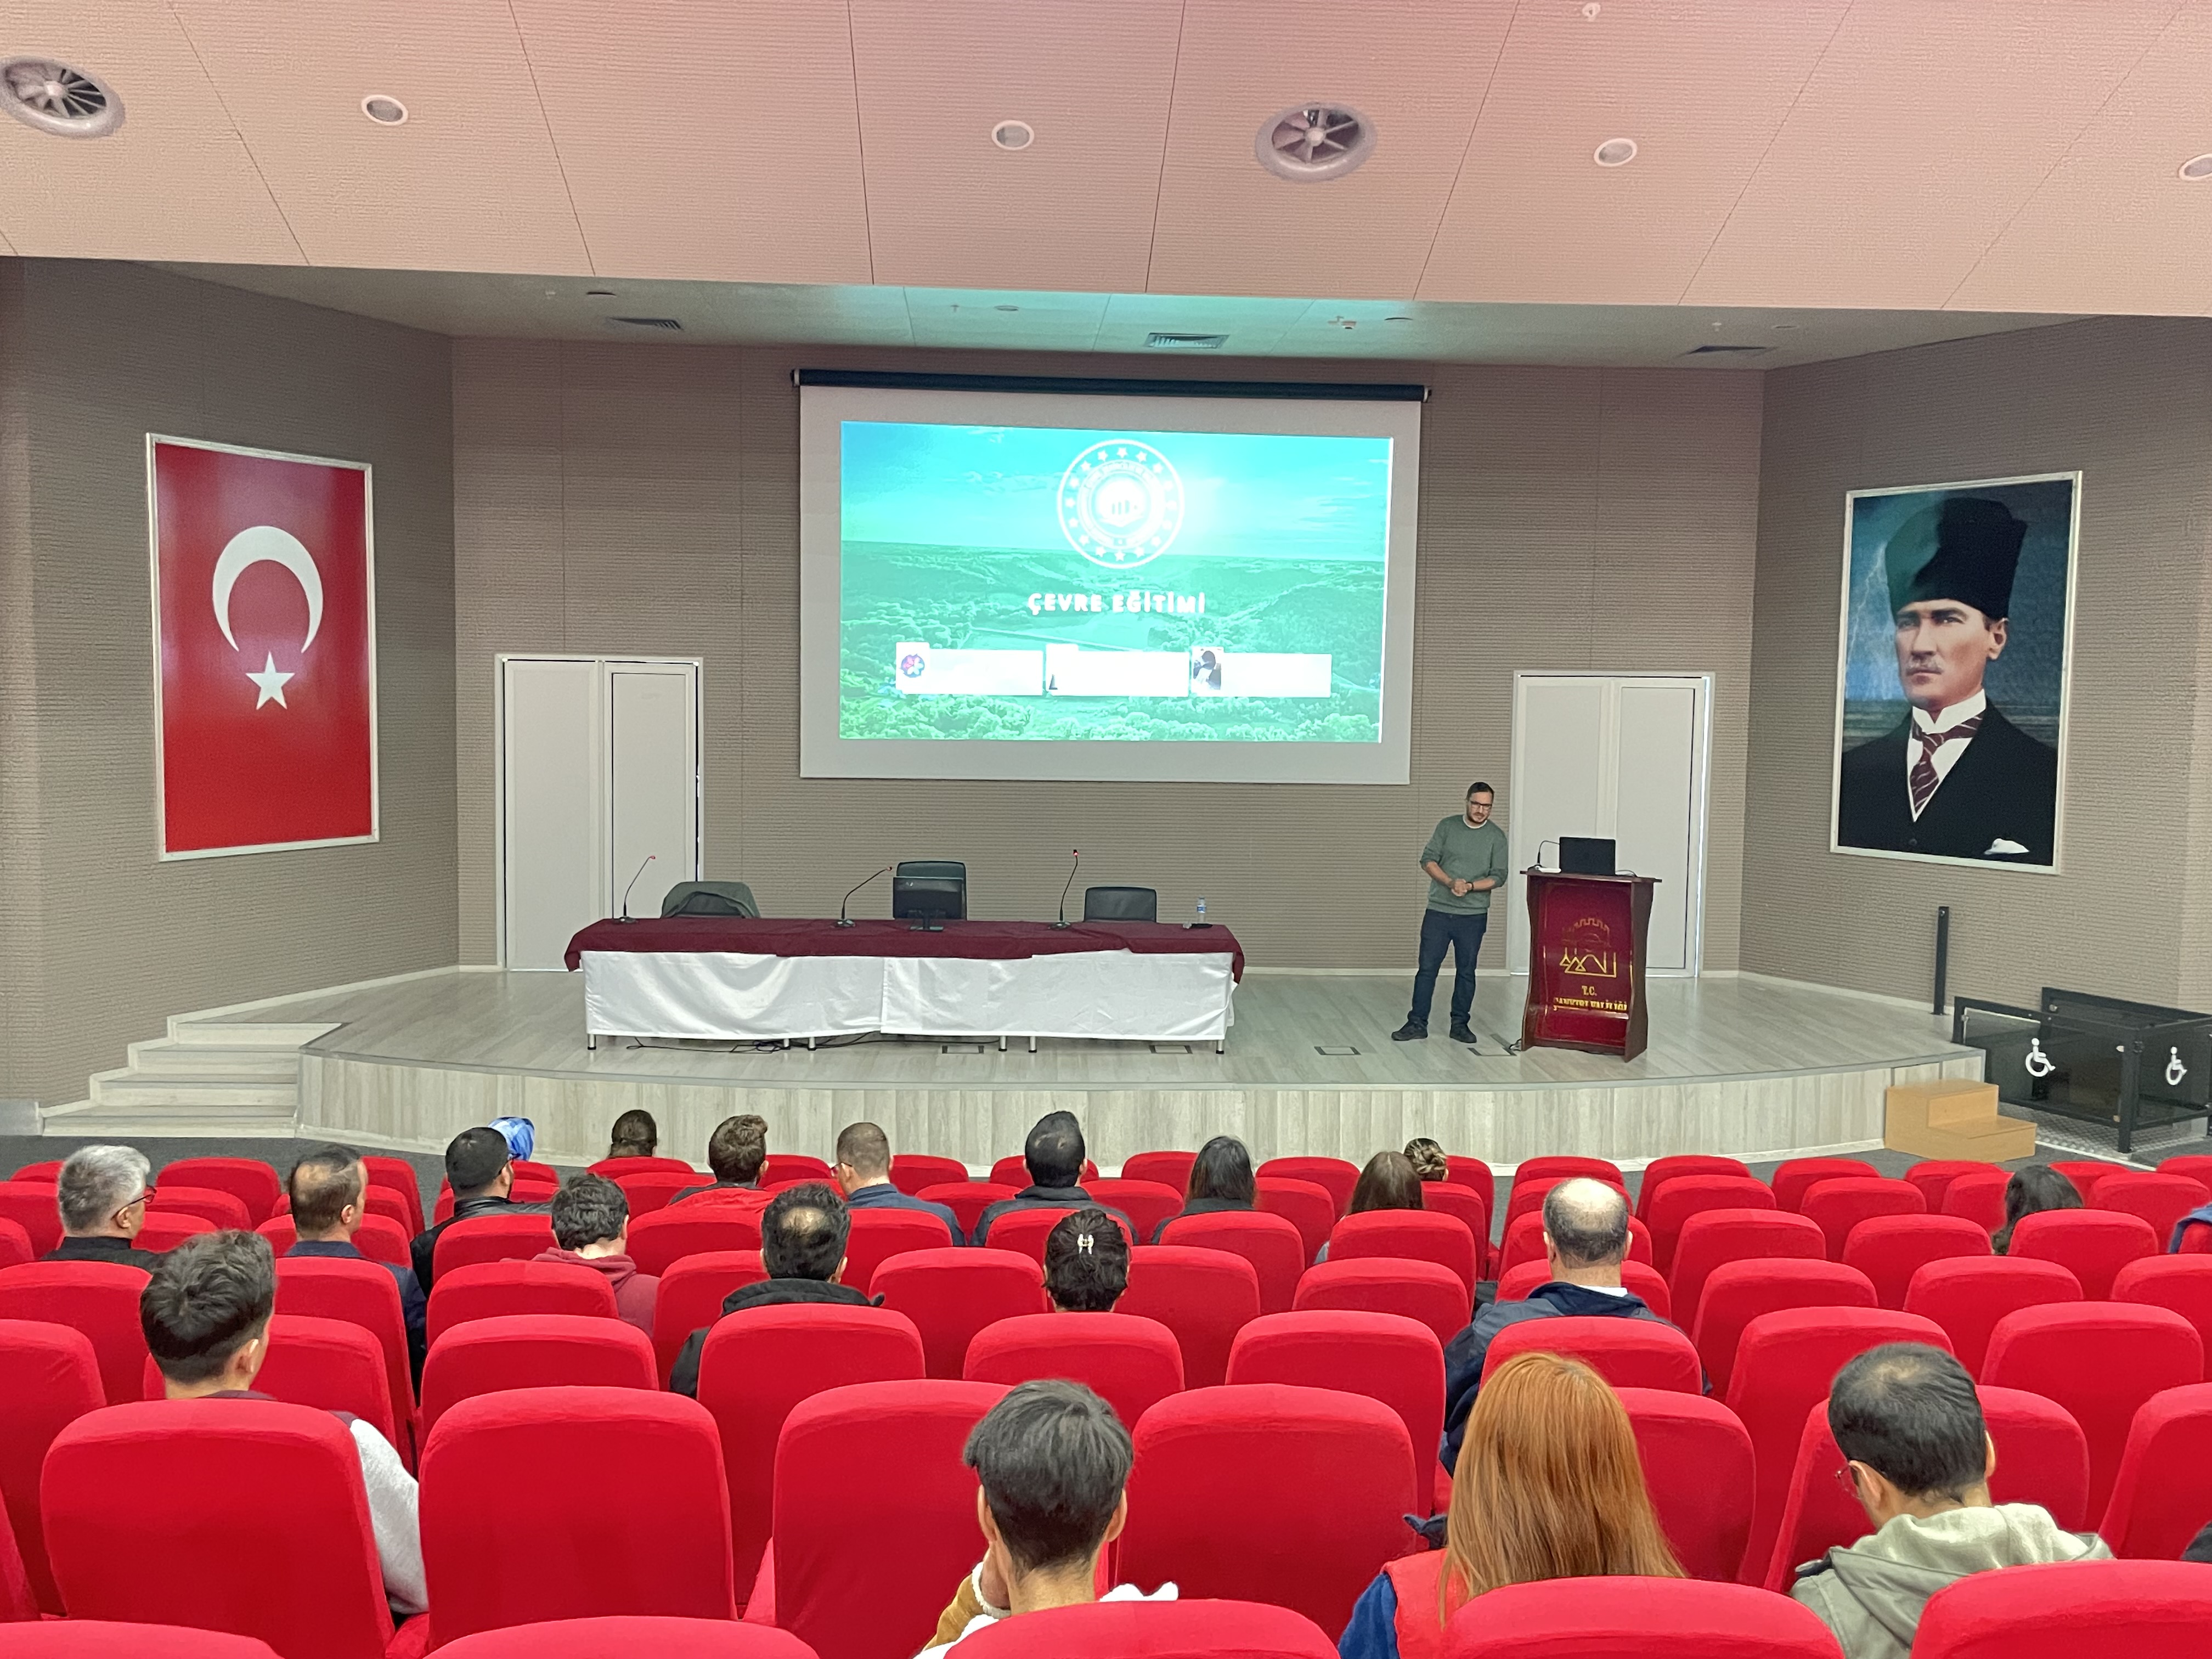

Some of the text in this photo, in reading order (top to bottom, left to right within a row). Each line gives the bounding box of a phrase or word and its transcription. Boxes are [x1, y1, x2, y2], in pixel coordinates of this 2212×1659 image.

[1028, 590, 1206, 616] ÇEVRE EĞİTİMİ
[1581, 985, 1598, 996] T.C.
